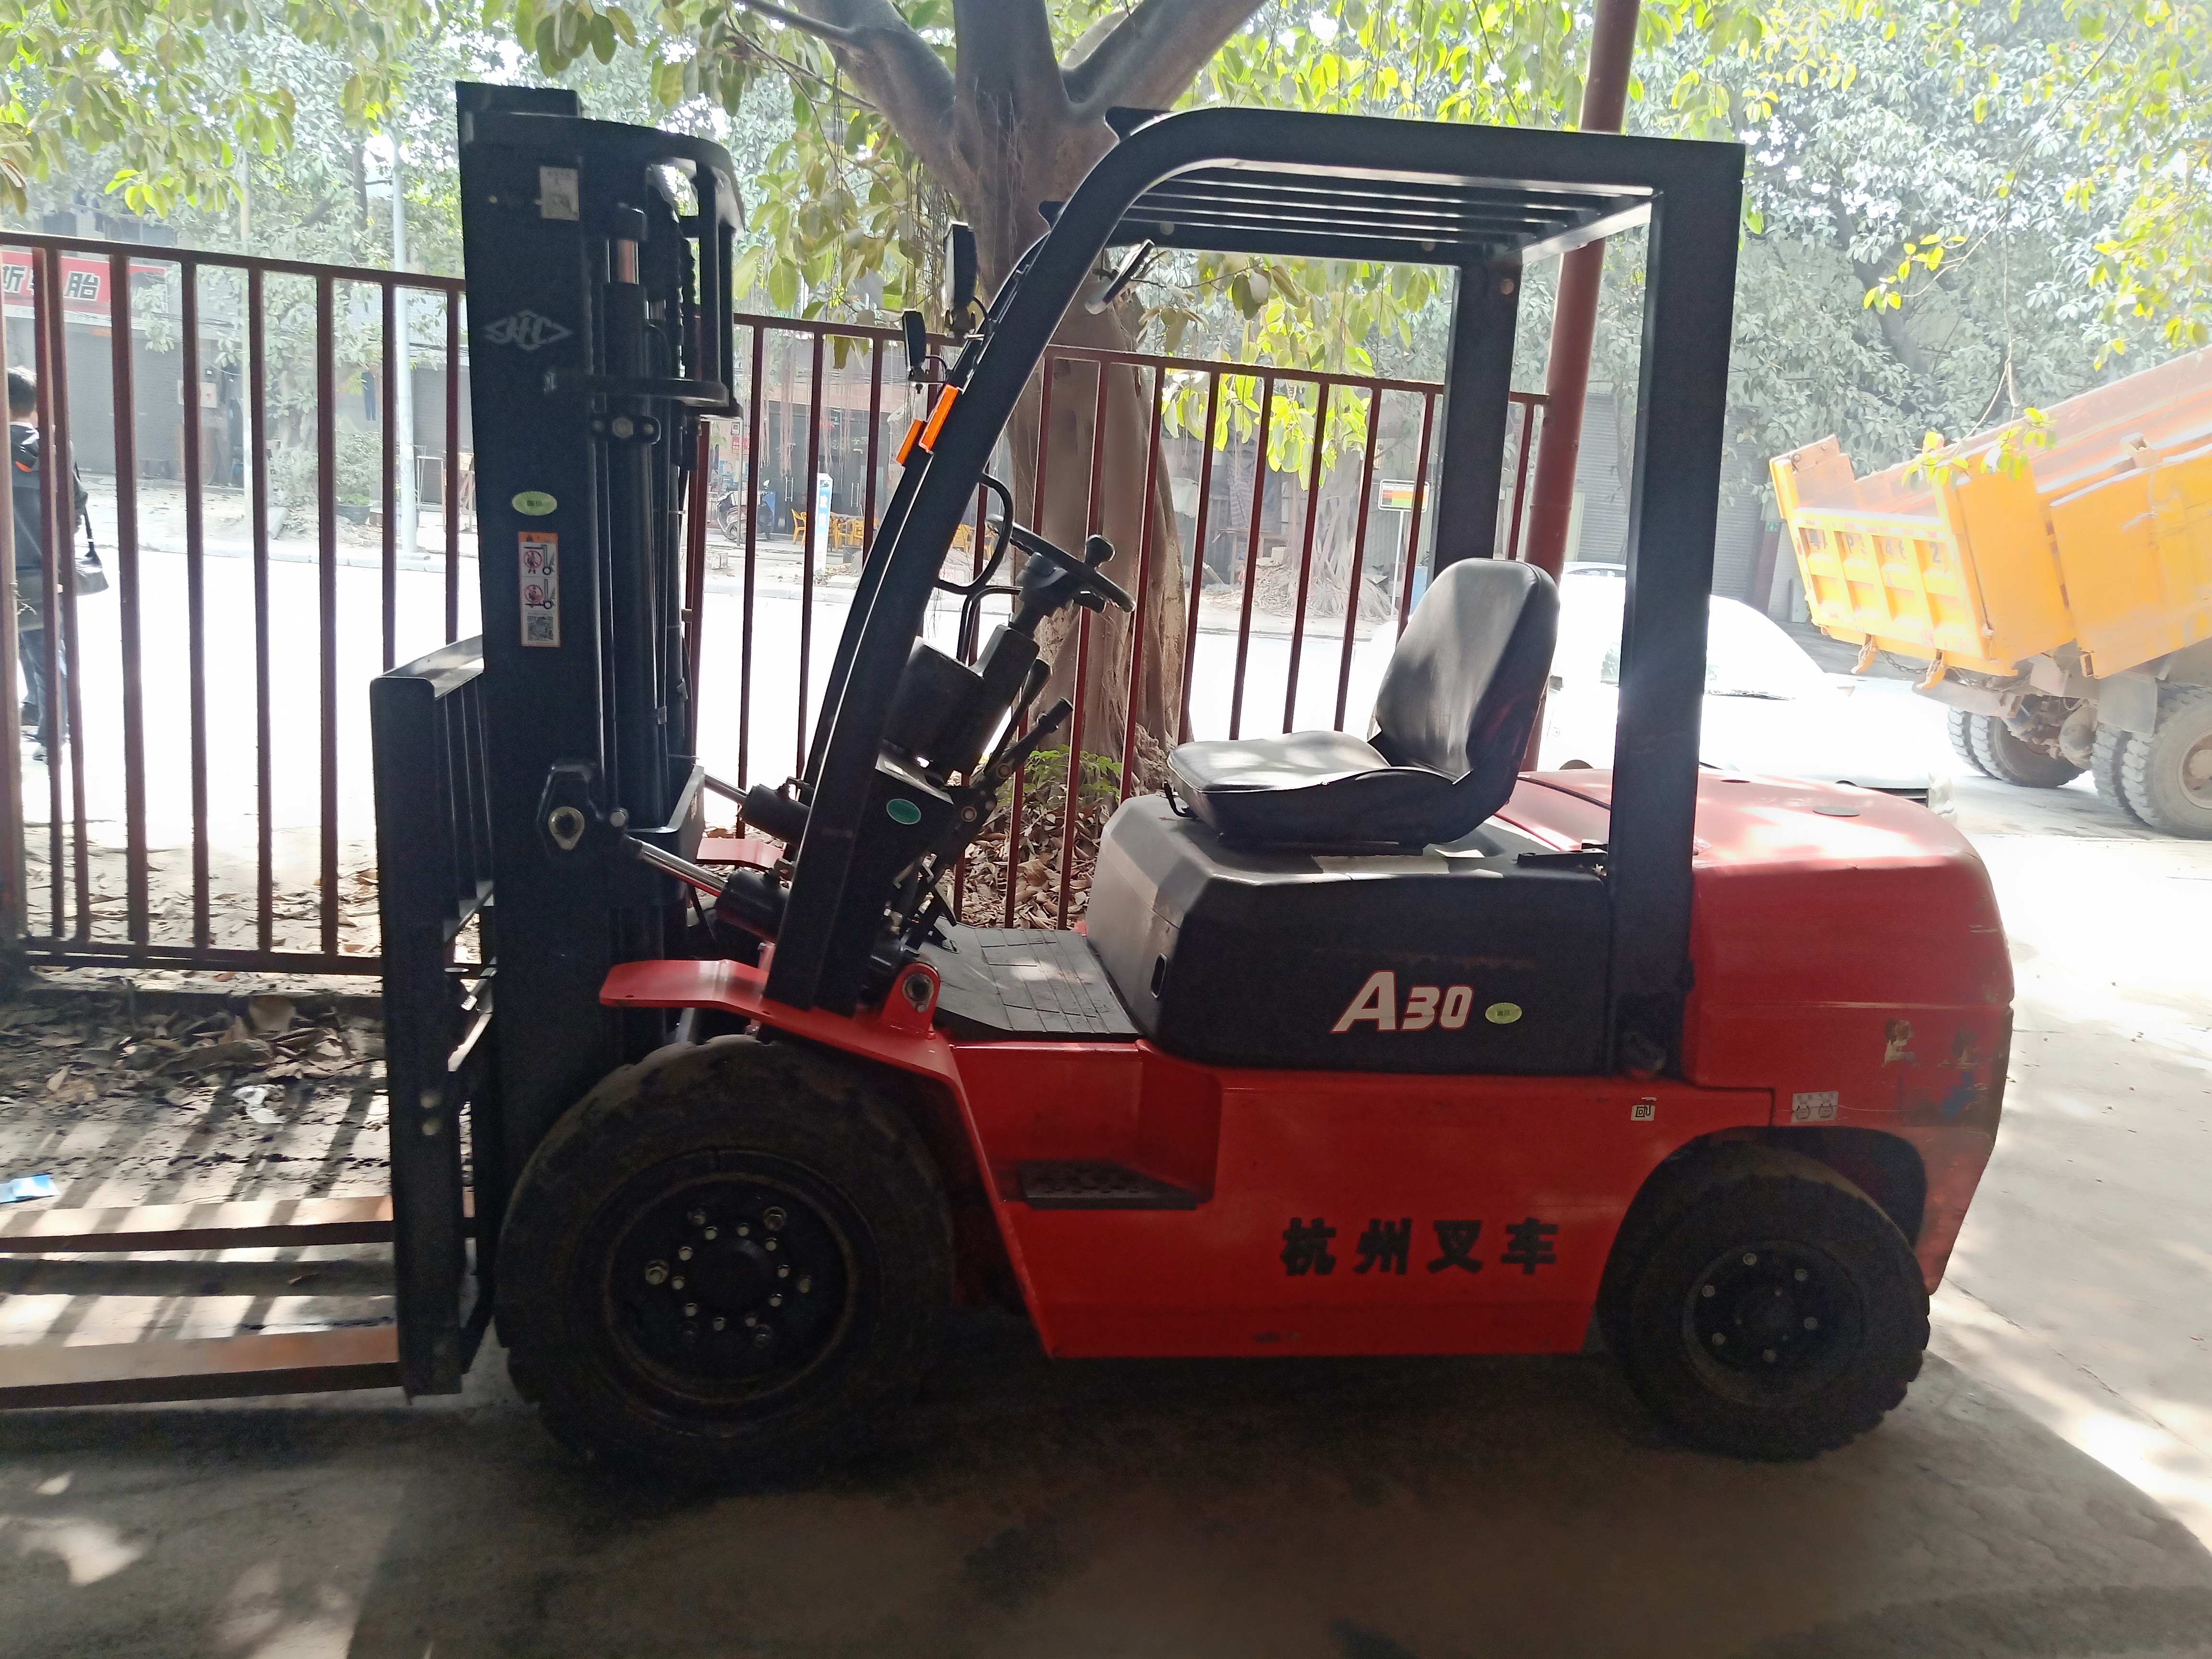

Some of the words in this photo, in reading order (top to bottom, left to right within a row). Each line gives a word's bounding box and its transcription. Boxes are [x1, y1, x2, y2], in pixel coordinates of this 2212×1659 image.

[1330, 970, 1474, 1033] A30
[1280, 1217, 1559, 1276] 杭州叉车
